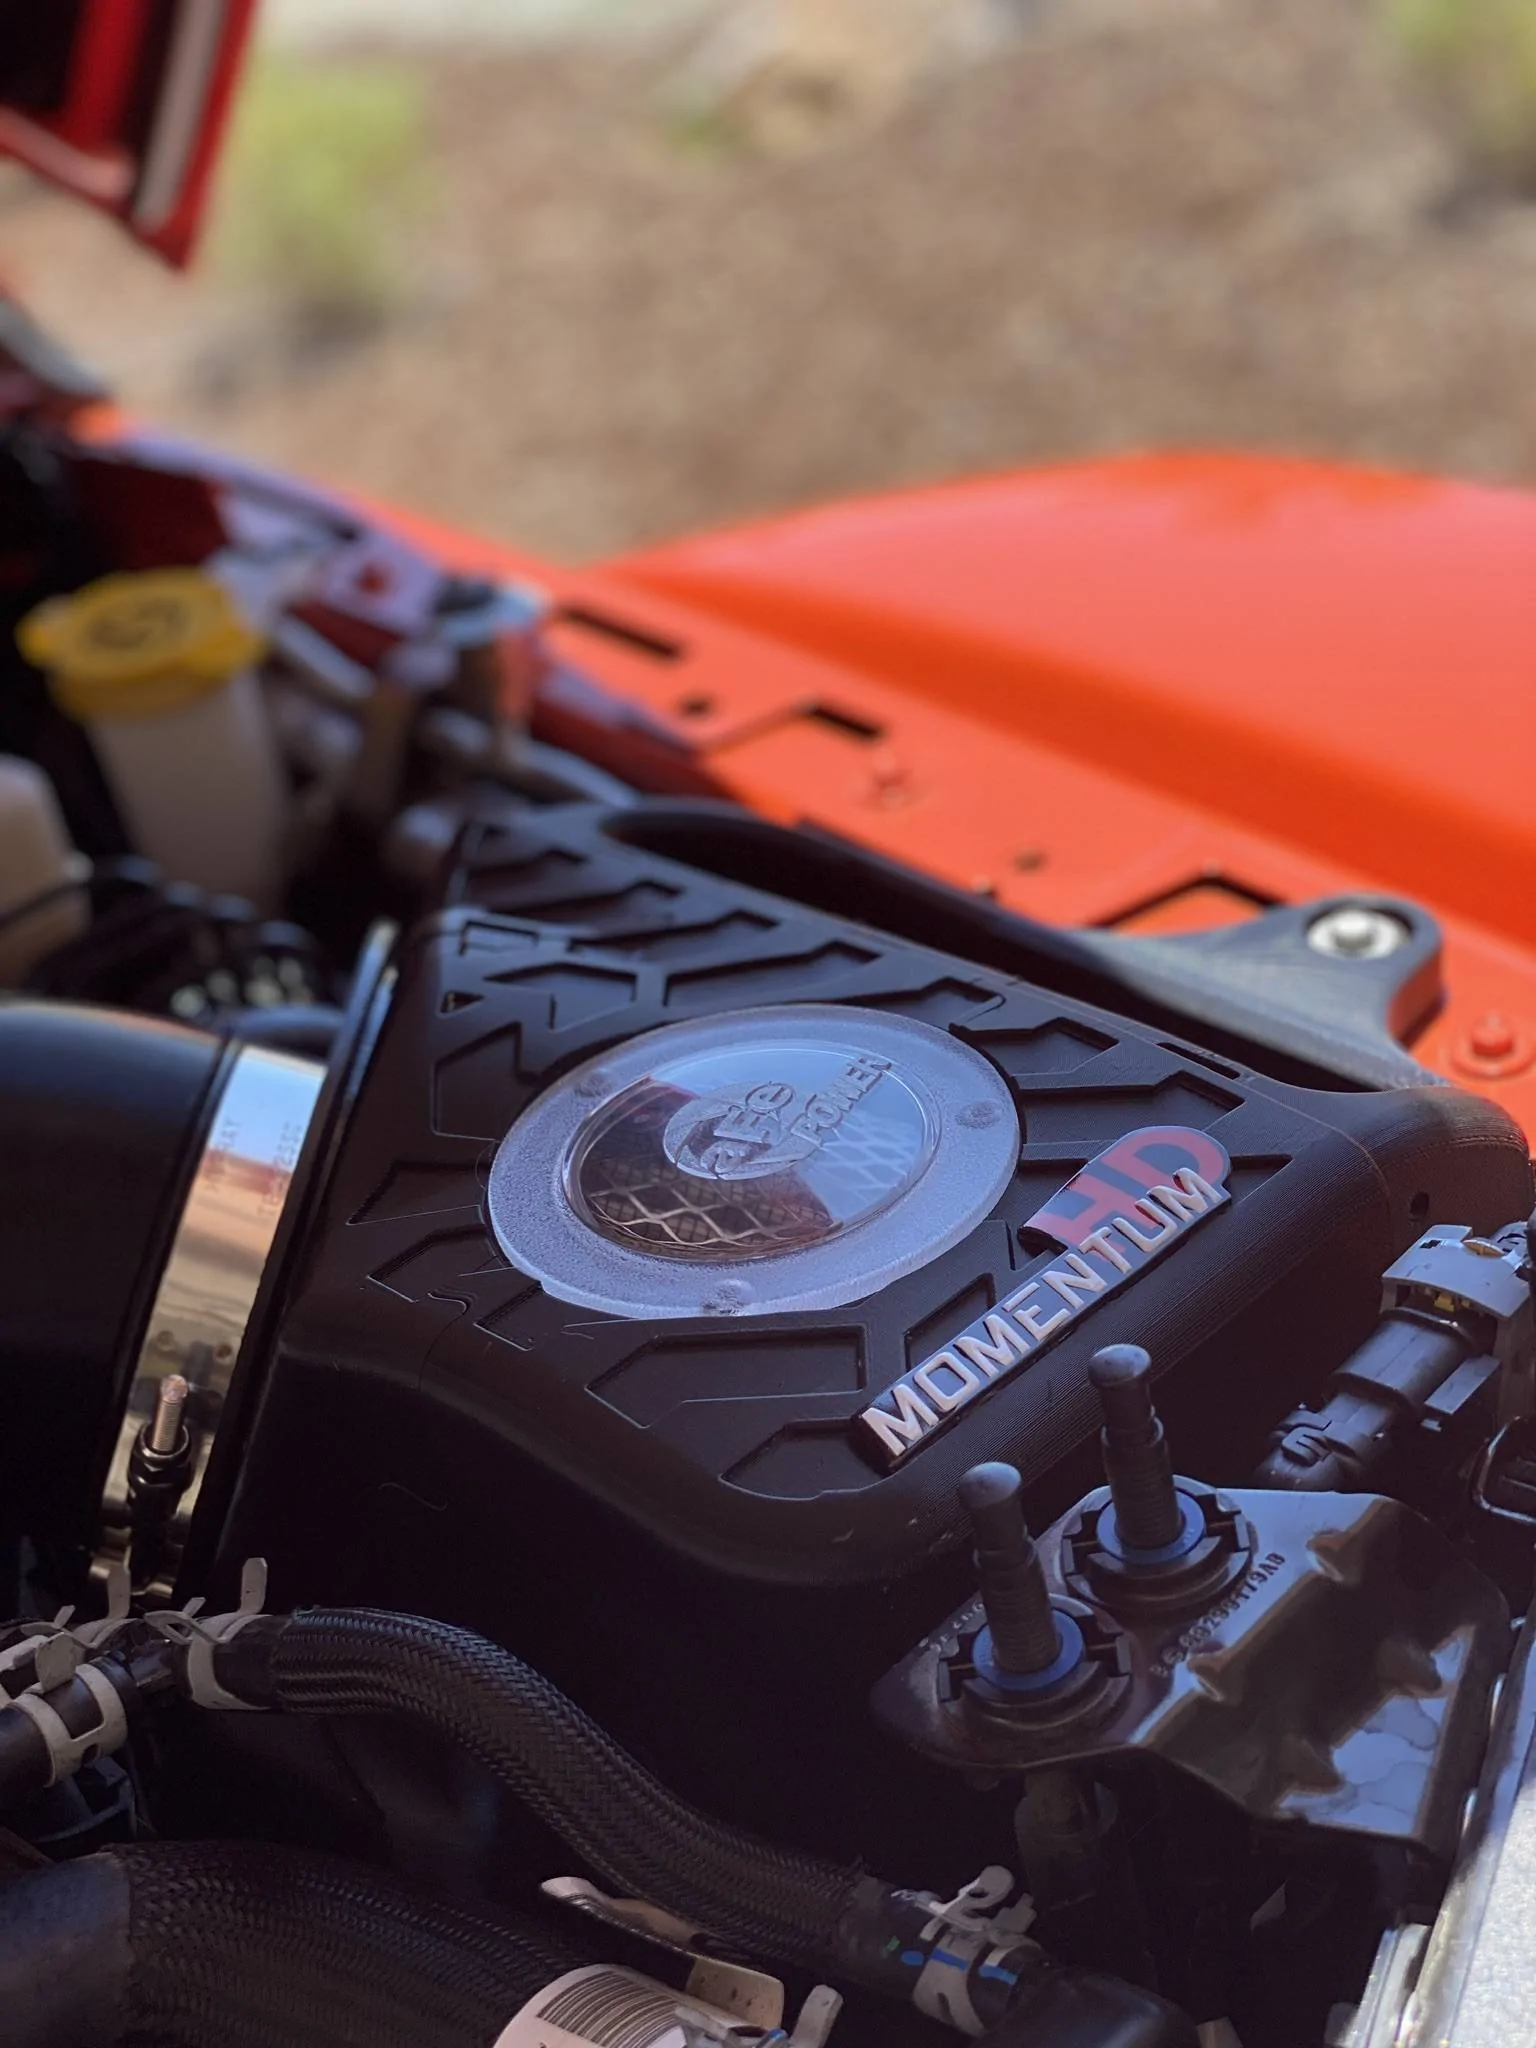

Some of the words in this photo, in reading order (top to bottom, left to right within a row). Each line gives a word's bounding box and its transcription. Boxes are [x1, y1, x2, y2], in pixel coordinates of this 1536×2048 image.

[790, 1056, 892, 1147] POWER
[1026, 1127, 1231, 1256] HD
[861, 1167, 1224, 1457] MOMENTUM
